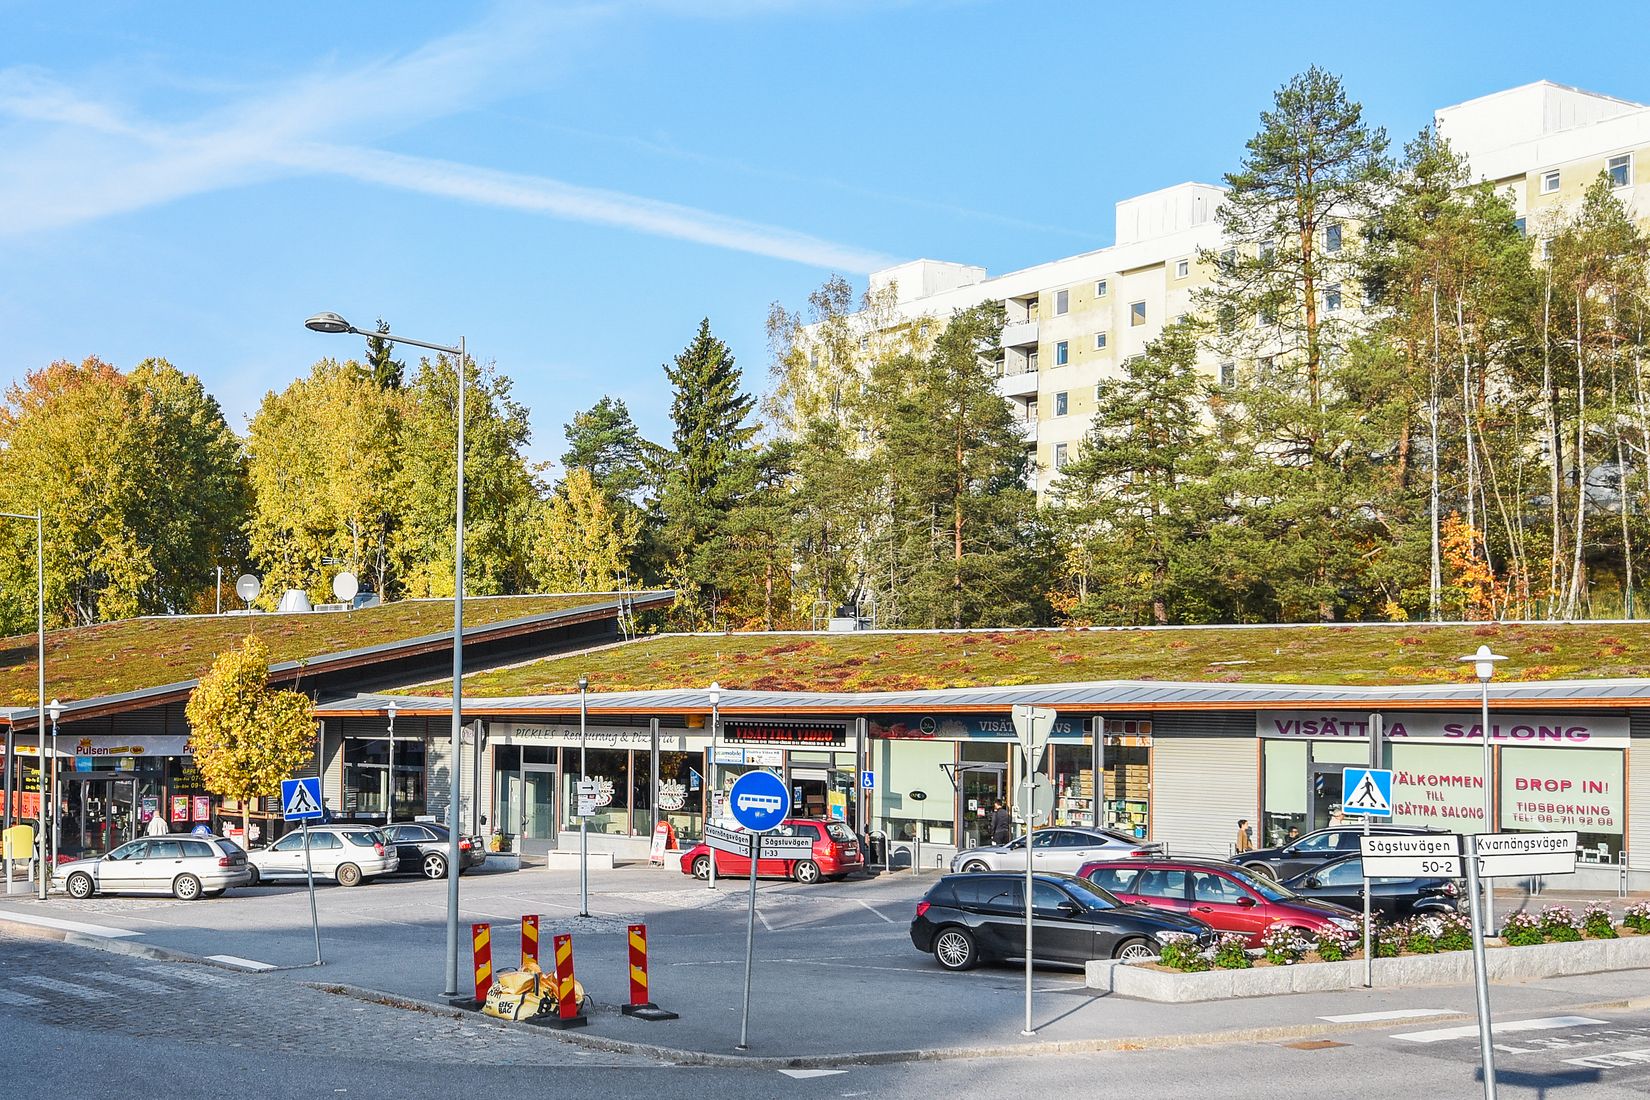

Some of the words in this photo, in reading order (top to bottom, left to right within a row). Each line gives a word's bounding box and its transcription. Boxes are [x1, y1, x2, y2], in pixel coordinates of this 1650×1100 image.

[979, 719, 1013, 732] VISÄT
[1274, 717, 1408, 737] VISÄTTA
[1443, 723, 1590, 741] SALONG
[515, 728, 556, 739] PICKLES
[619, 732, 629, 743] &
[797, 729, 832, 741] VIDEO
[76, 746, 109, 755] Pulsen
[1515, 778, 1572, 792] DROP
[1583, 781, 1609, 794] IN!
[1426, 790, 1444, 801] TILL
[1391, 801, 1437, 817] ISÄTTRA
[1441, 806, 1484, 819] SALONG
[765, 838, 809, 847] Sågstuvägen
[1369, 840, 1450, 855] Sågstuvägen
[1477, 837, 1569, 852] Kvarnängsvägen
[1422, 861, 1453, 873] 50-2
